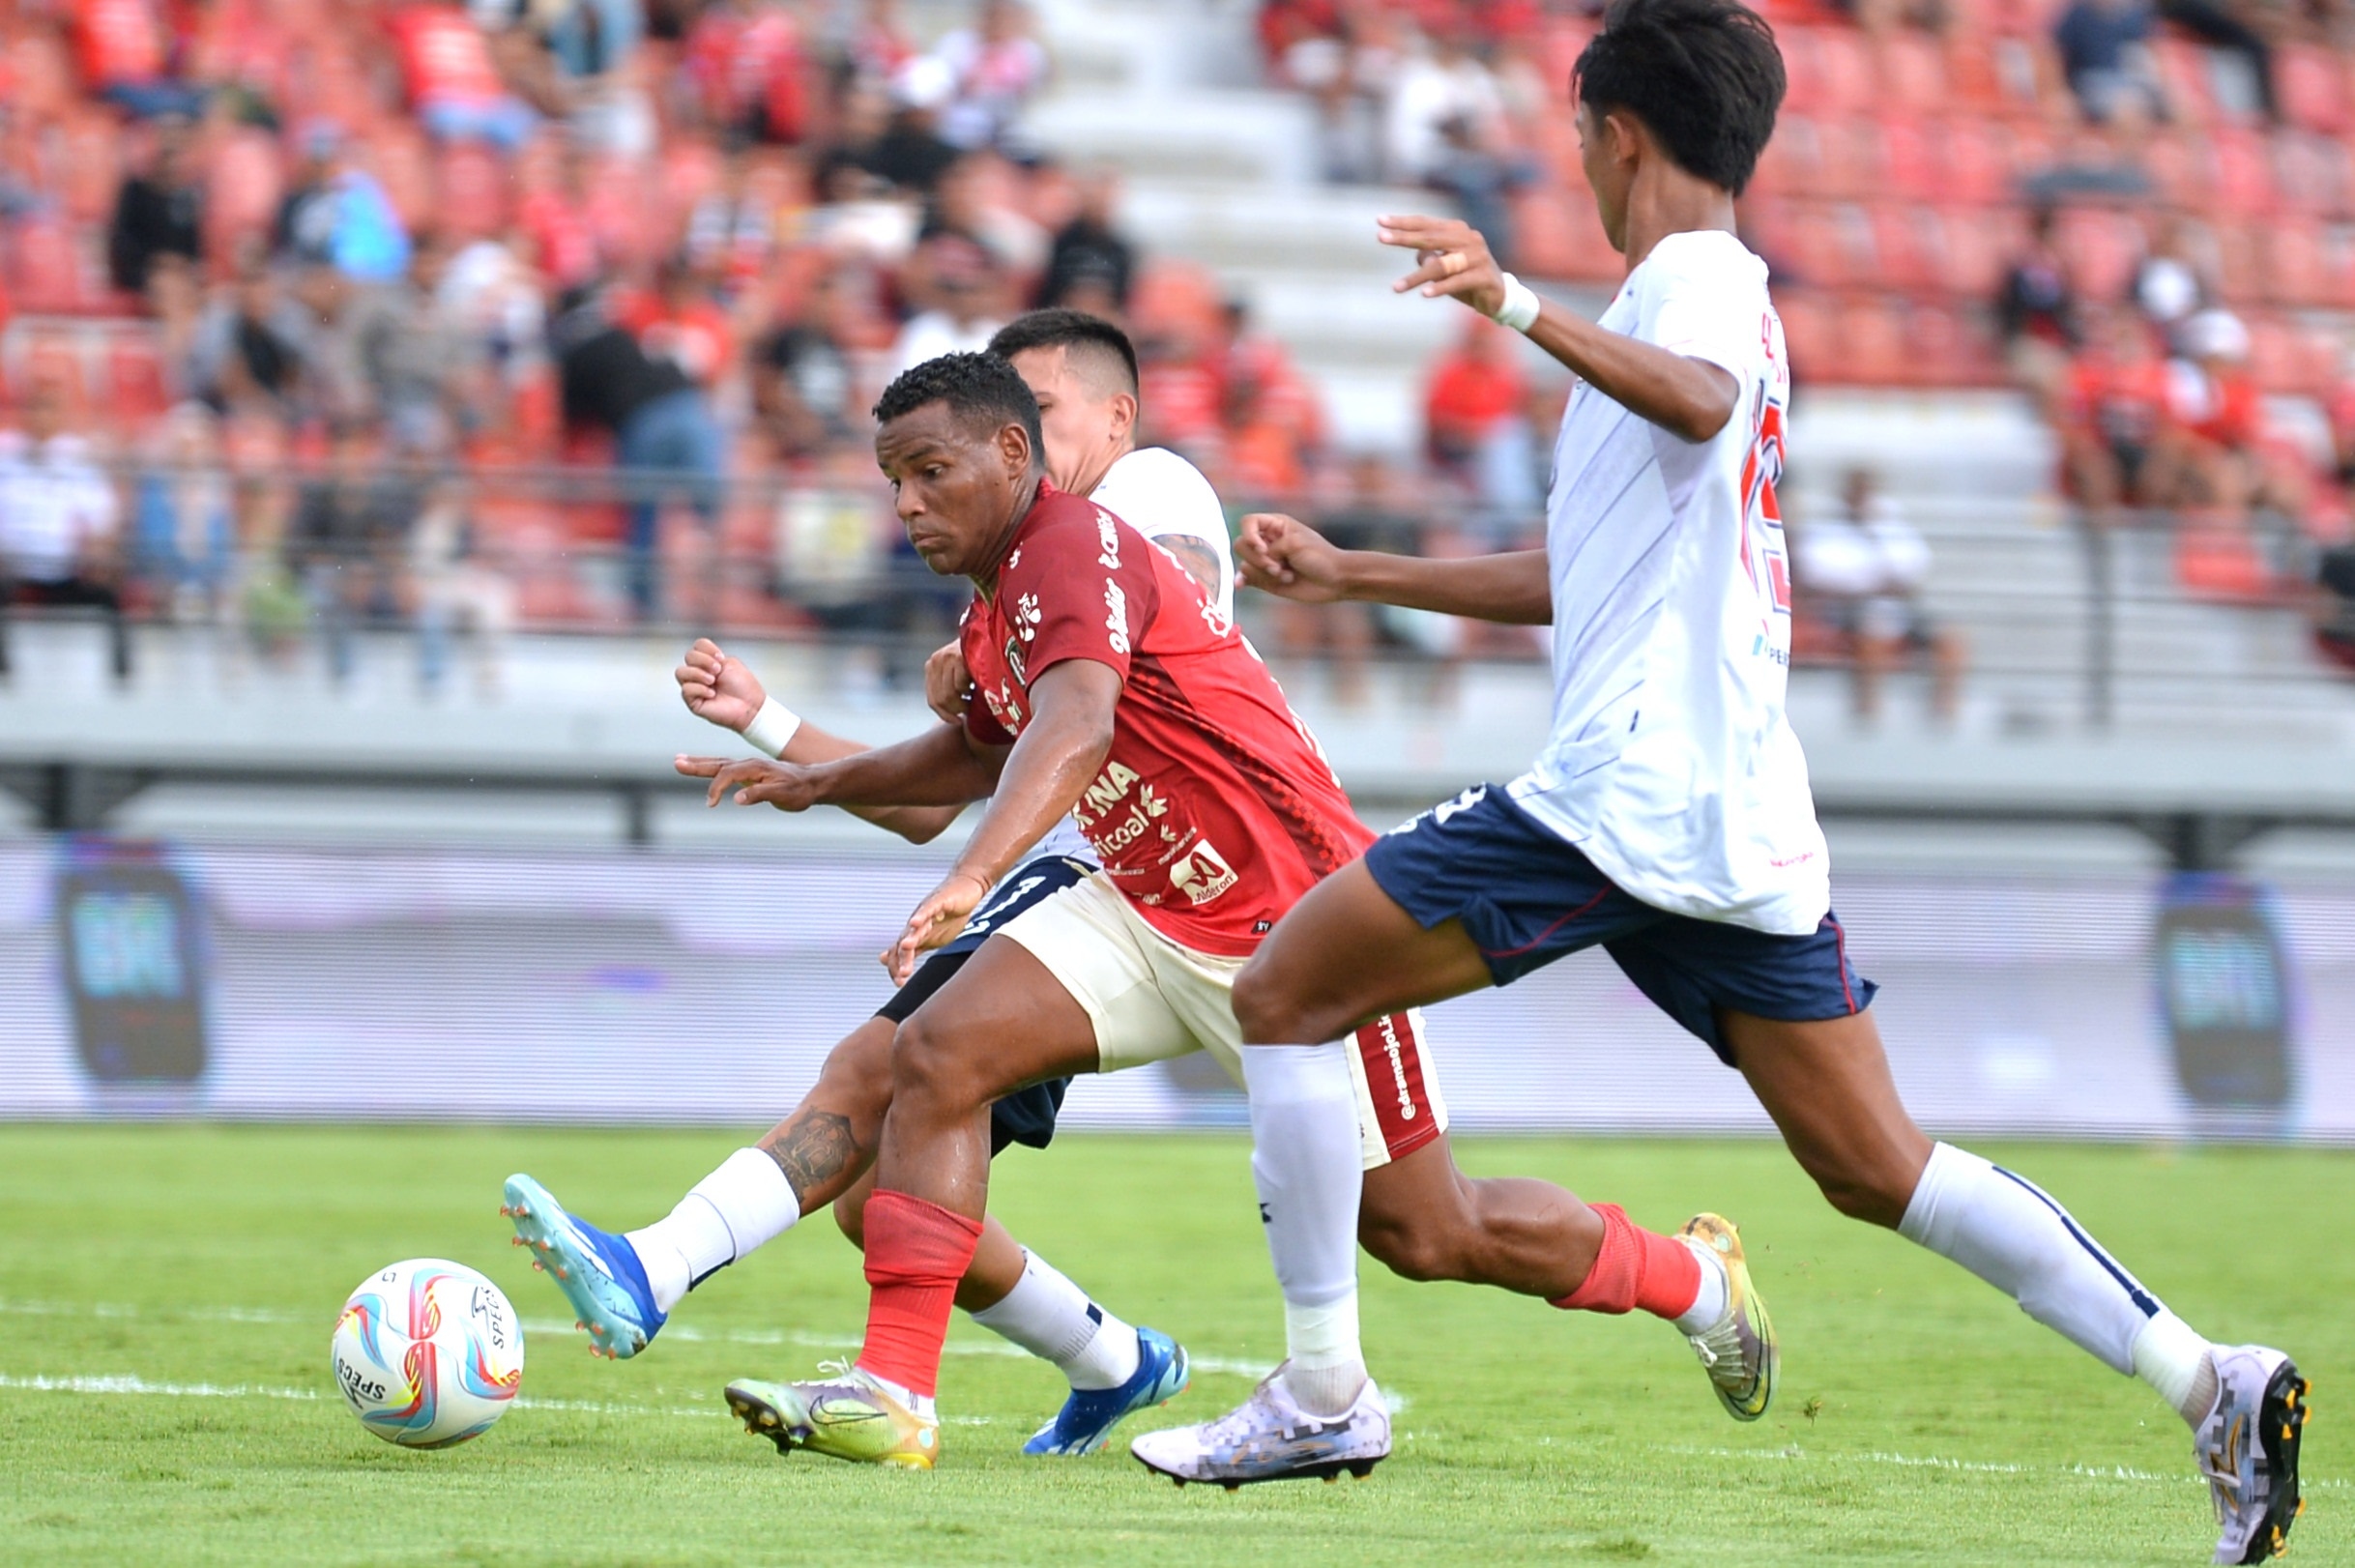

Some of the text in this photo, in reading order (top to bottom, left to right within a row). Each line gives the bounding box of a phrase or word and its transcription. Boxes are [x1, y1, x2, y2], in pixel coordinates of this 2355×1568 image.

[1084, 760, 1140, 818] INA
[1194, 874, 1236, 905] Alderon
[480, 1286, 505, 1350] SPECS
[337, 1357, 386, 1401] SPECS
